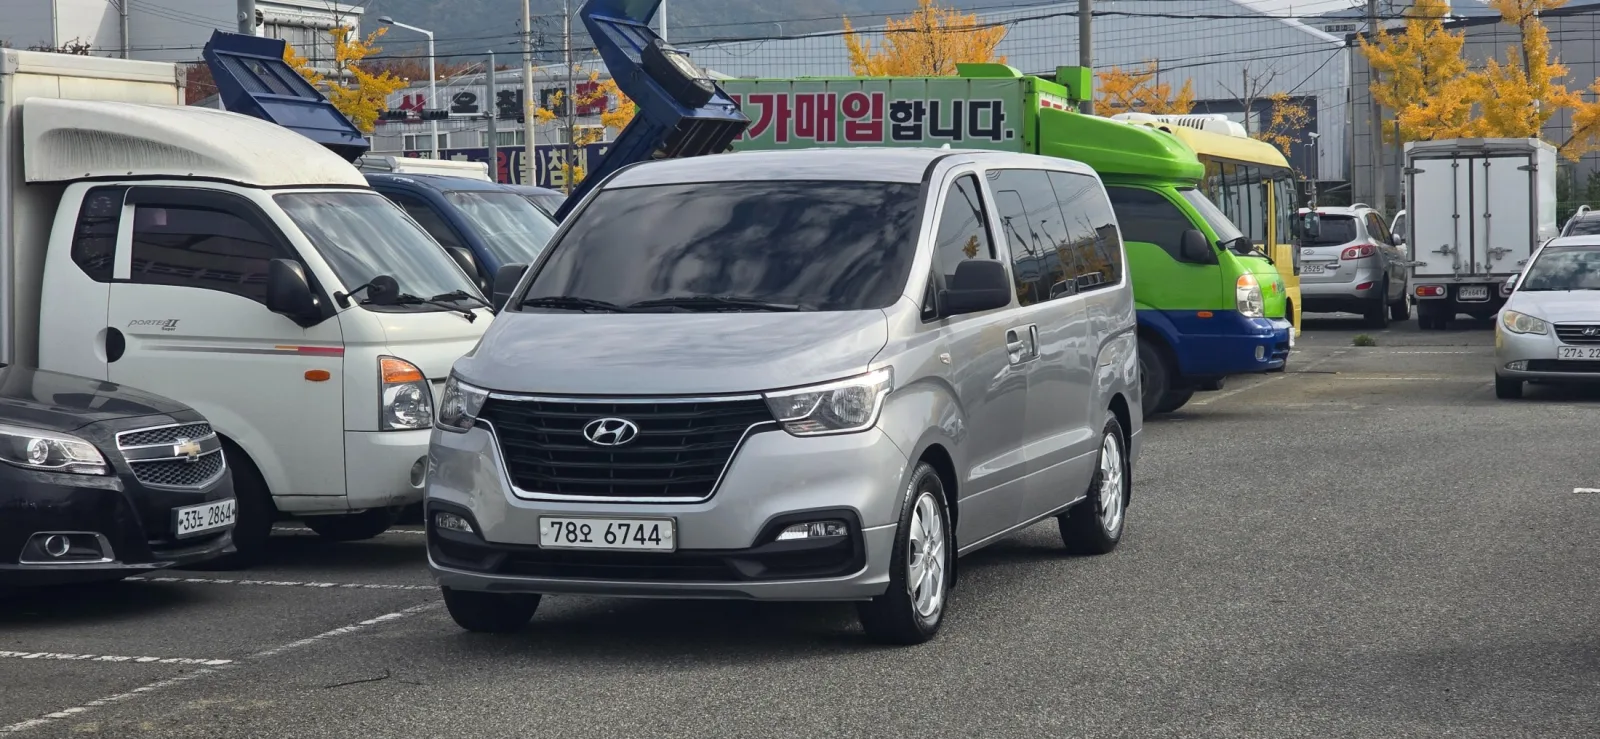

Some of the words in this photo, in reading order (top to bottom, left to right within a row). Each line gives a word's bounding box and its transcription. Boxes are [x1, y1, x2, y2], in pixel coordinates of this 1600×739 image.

[729, 92, 884, 142] 가매입
[208, 502, 231, 526] 2864
[550, 521, 593, 543] 78오
[604, 523, 662, 546] 6744
